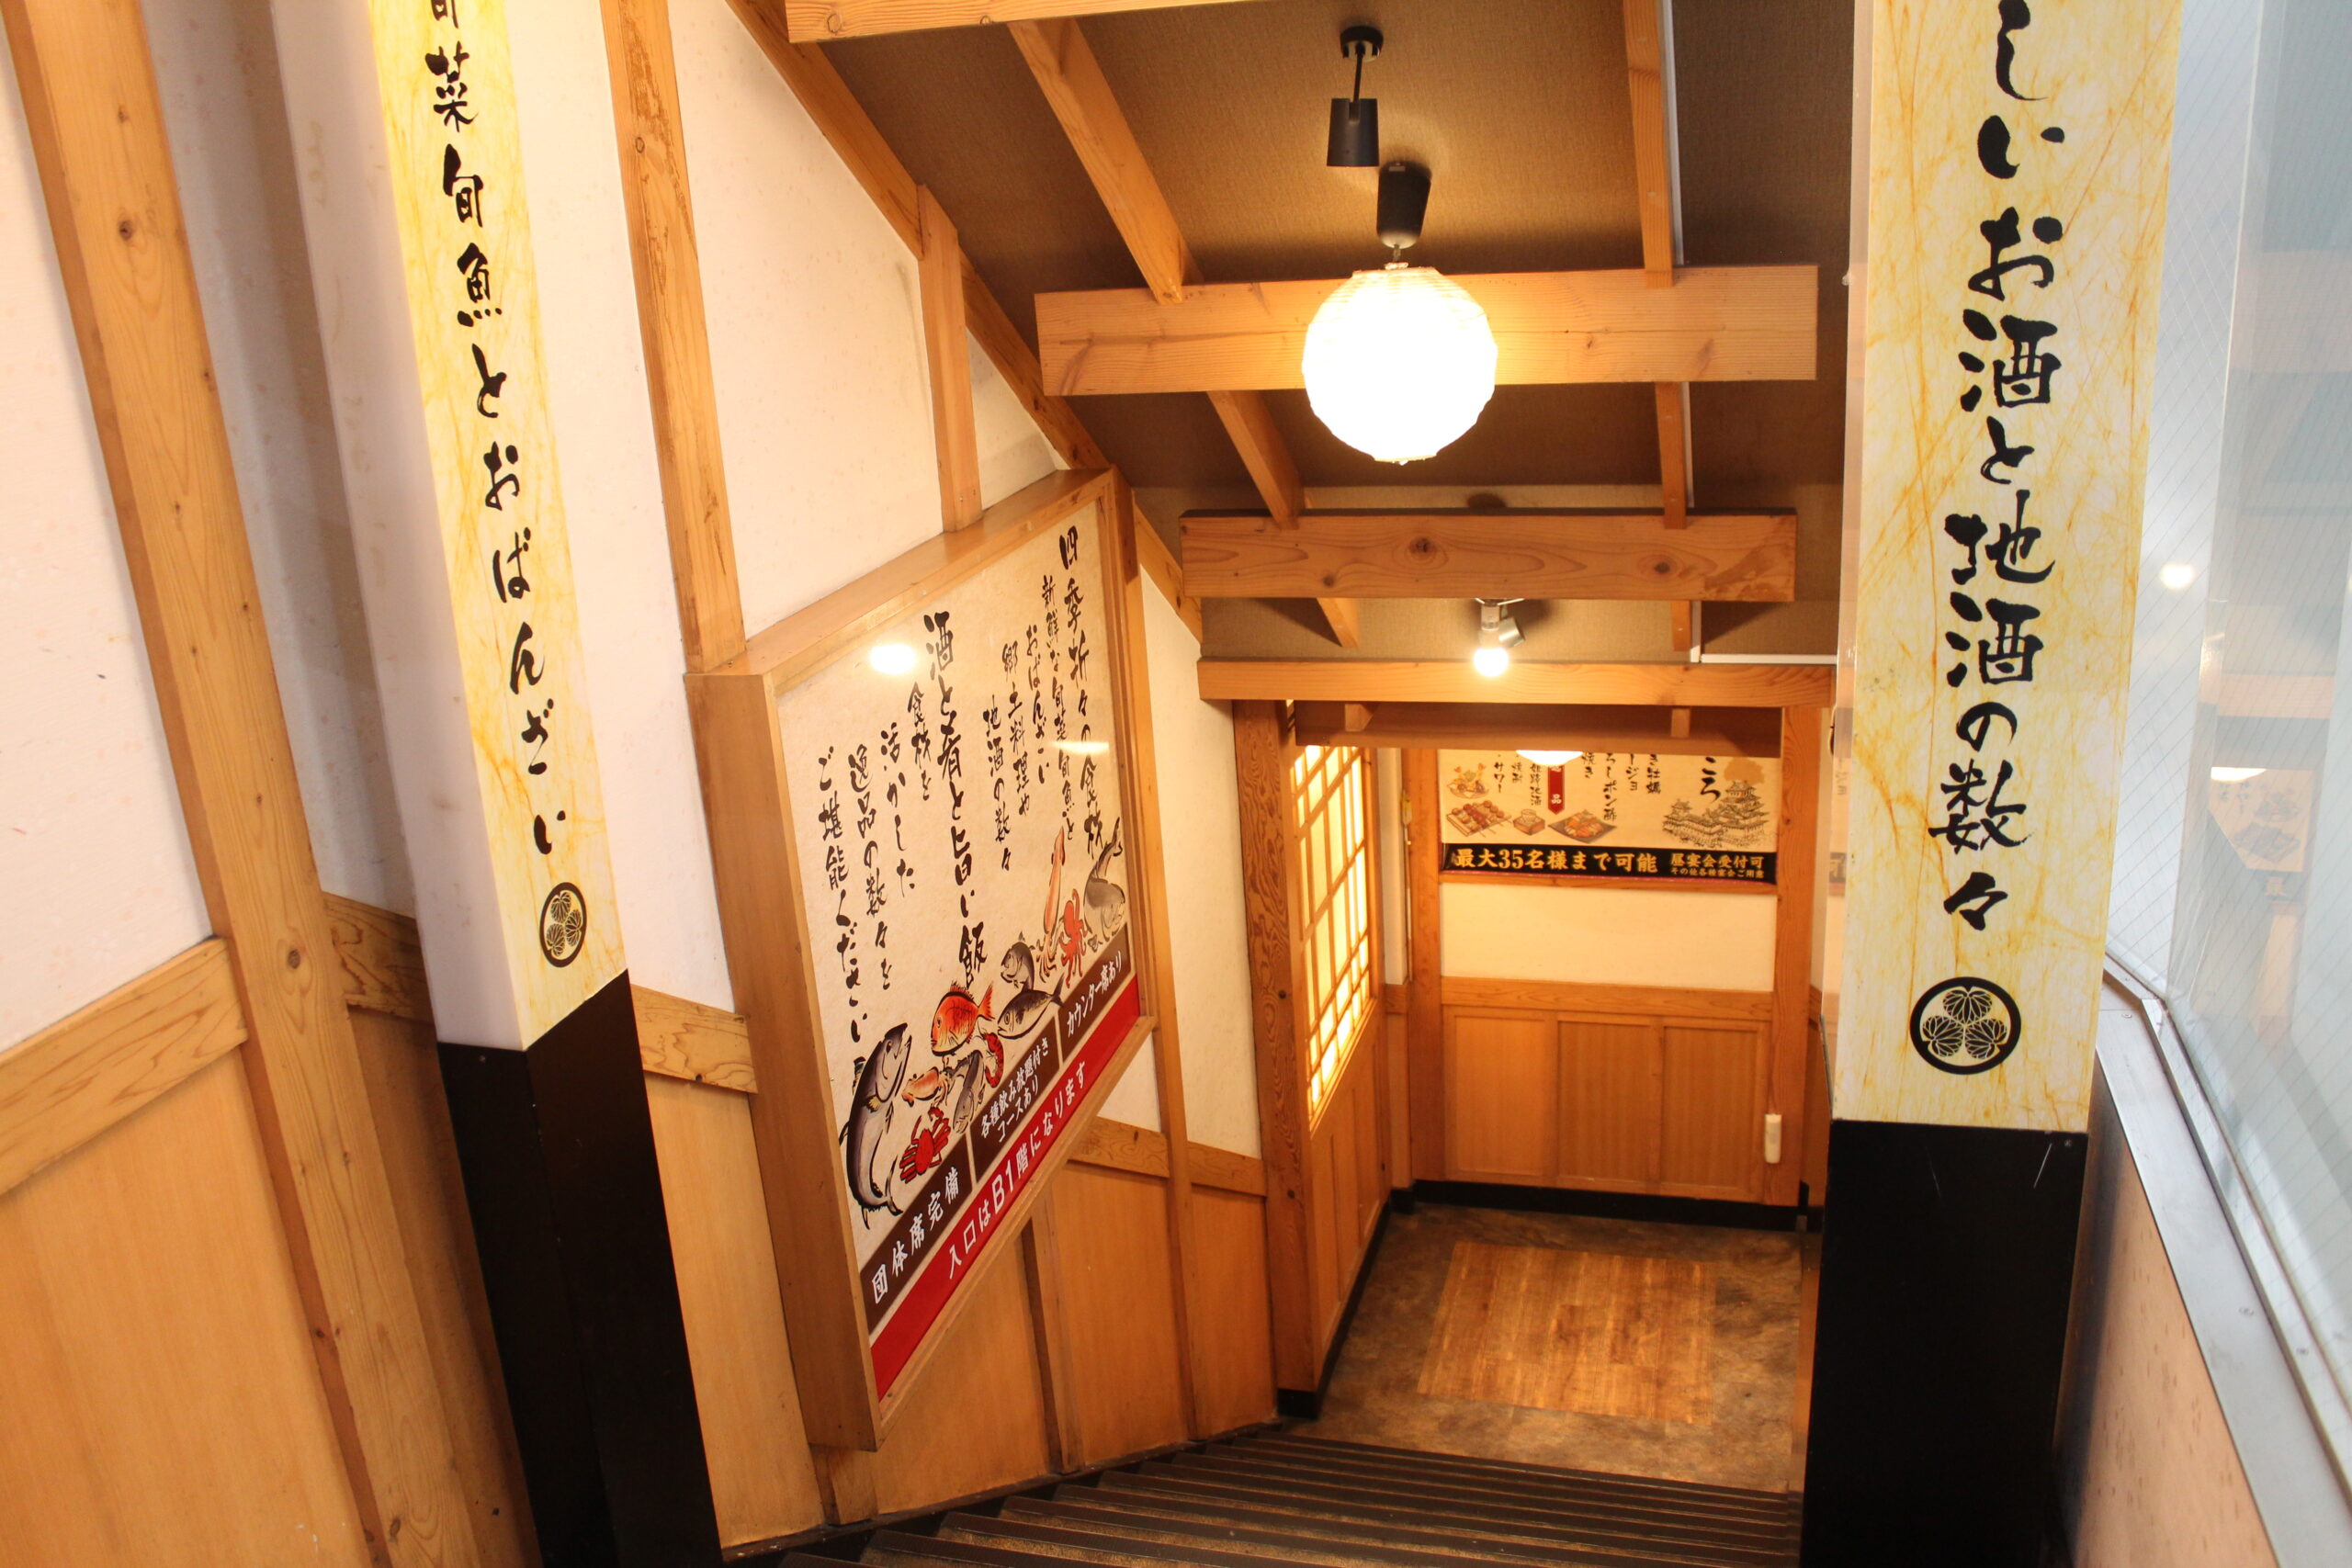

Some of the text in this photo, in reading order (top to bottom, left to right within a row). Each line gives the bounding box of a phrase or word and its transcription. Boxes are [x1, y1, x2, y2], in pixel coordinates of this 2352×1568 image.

[1002, 640, 1031, 816] 郷土料理や
[1026, 624, 1050, 784] おばんざい
[880, 722, 916, 898] 活かした
[983, 694, 1011, 872] 地酒の数々
[818, 745, 868, 1043] ご堪能ください
[1454, 847, 1658, 874] 最大35名様まで可能
[1670, 852, 1765, 869] 昼宴会受付可
[1066, 950, 1123, 1039] カウンター席あり
[980, 1036, 1049, 1139] 各種飲み放題付き
[997, 1075, 1039, 1143] コースあり
[871, 1167, 961, 1304] 団体席完備
[947, 1060, 1088, 1280] 入口はB1階になります
